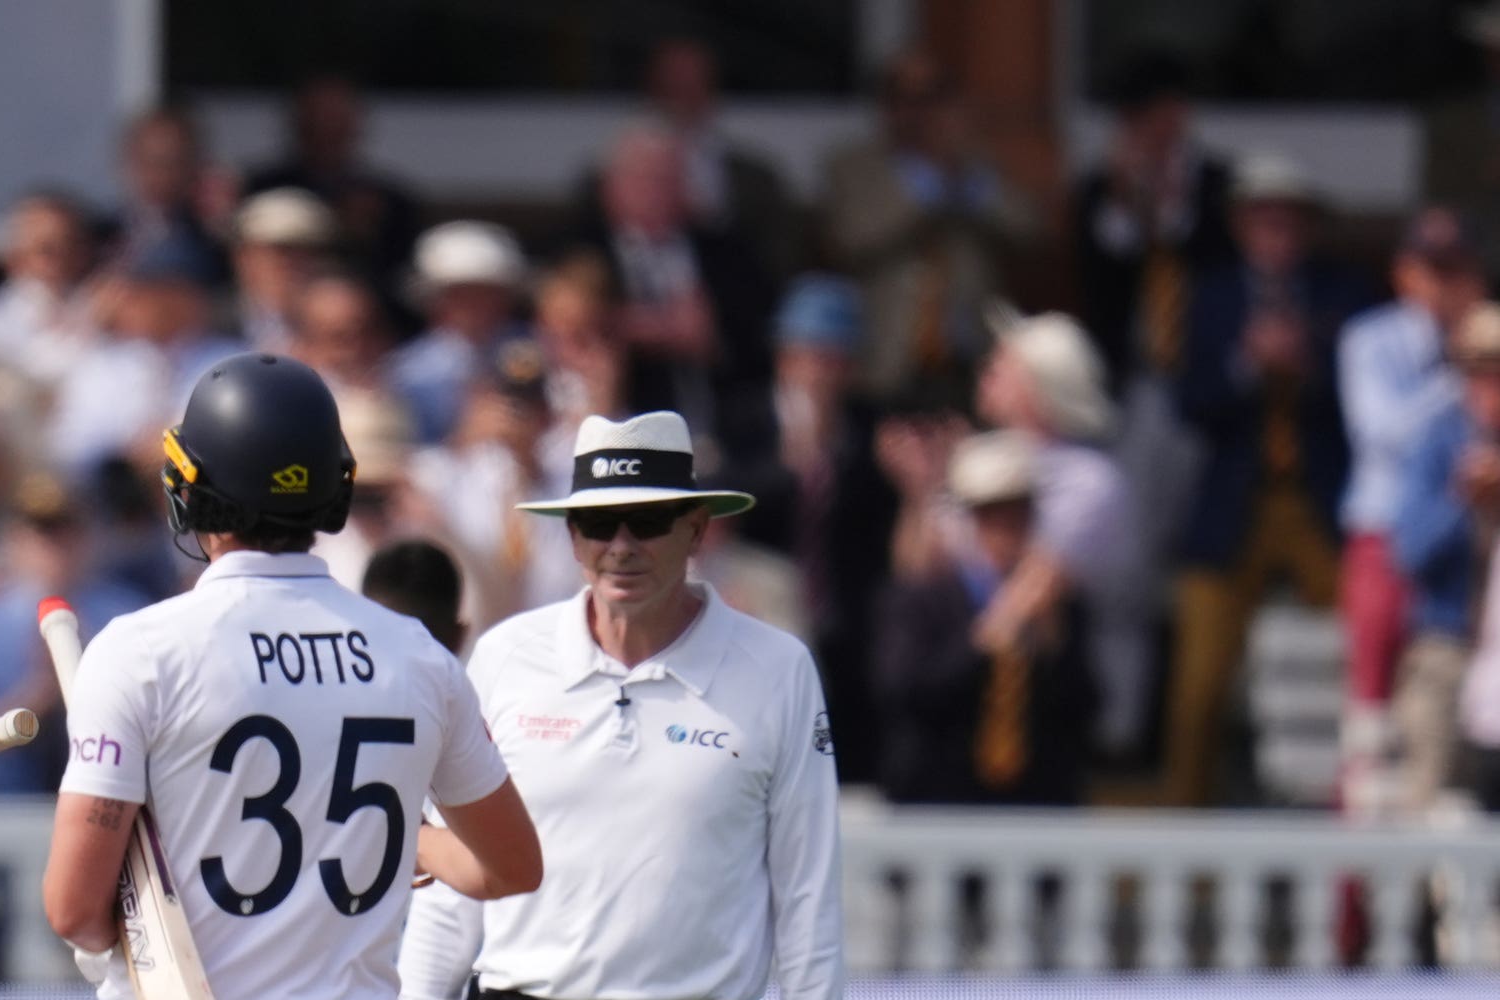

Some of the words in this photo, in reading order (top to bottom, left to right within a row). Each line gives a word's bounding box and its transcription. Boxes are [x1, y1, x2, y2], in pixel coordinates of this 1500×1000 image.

[608, 458, 643, 477] ICC
[250, 630, 376, 684] POTTS
[689, 729, 730, 749] ICC
[199, 713, 416, 917] 35
